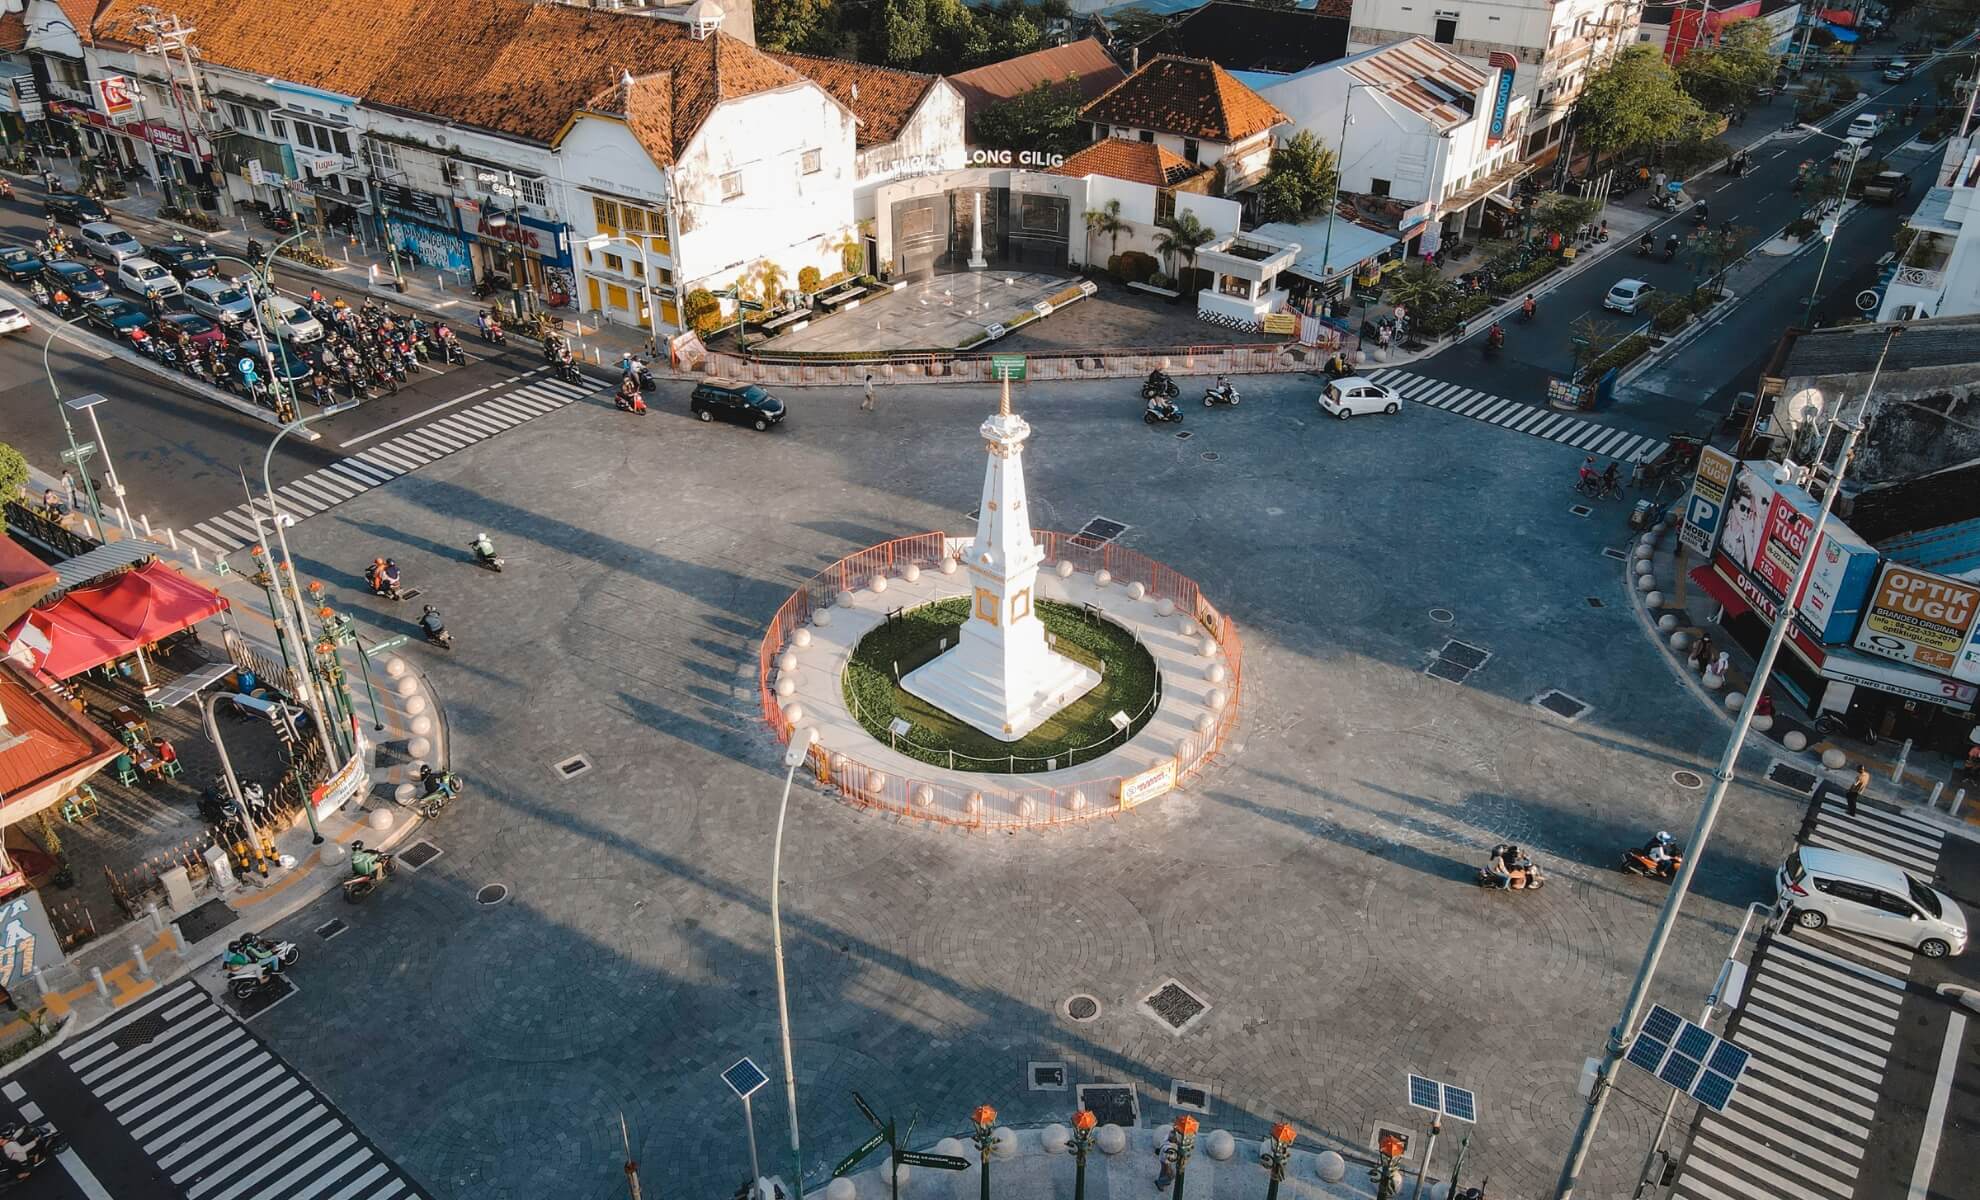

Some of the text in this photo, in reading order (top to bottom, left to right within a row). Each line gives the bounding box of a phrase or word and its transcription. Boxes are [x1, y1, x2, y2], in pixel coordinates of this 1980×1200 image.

[1019, 151, 1064, 168] GILIG
[1702, 463, 1729, 483] TUGU
[1705, 457, 1729, 473] OPTIK
[1692, 499, 1714, 524] P
[1685, 522, 1711, 542] MOBIL
[1889, 574, 1973, 608] OPTIK
[1886, 589, 1968, 624] TUGU
[1876, 608, 1961, 637] BRANDED ORIGINAL
[1882, 625, 1944, 647] optiktugu.com
[1860, 641, 1910, 660] OAKLEY
